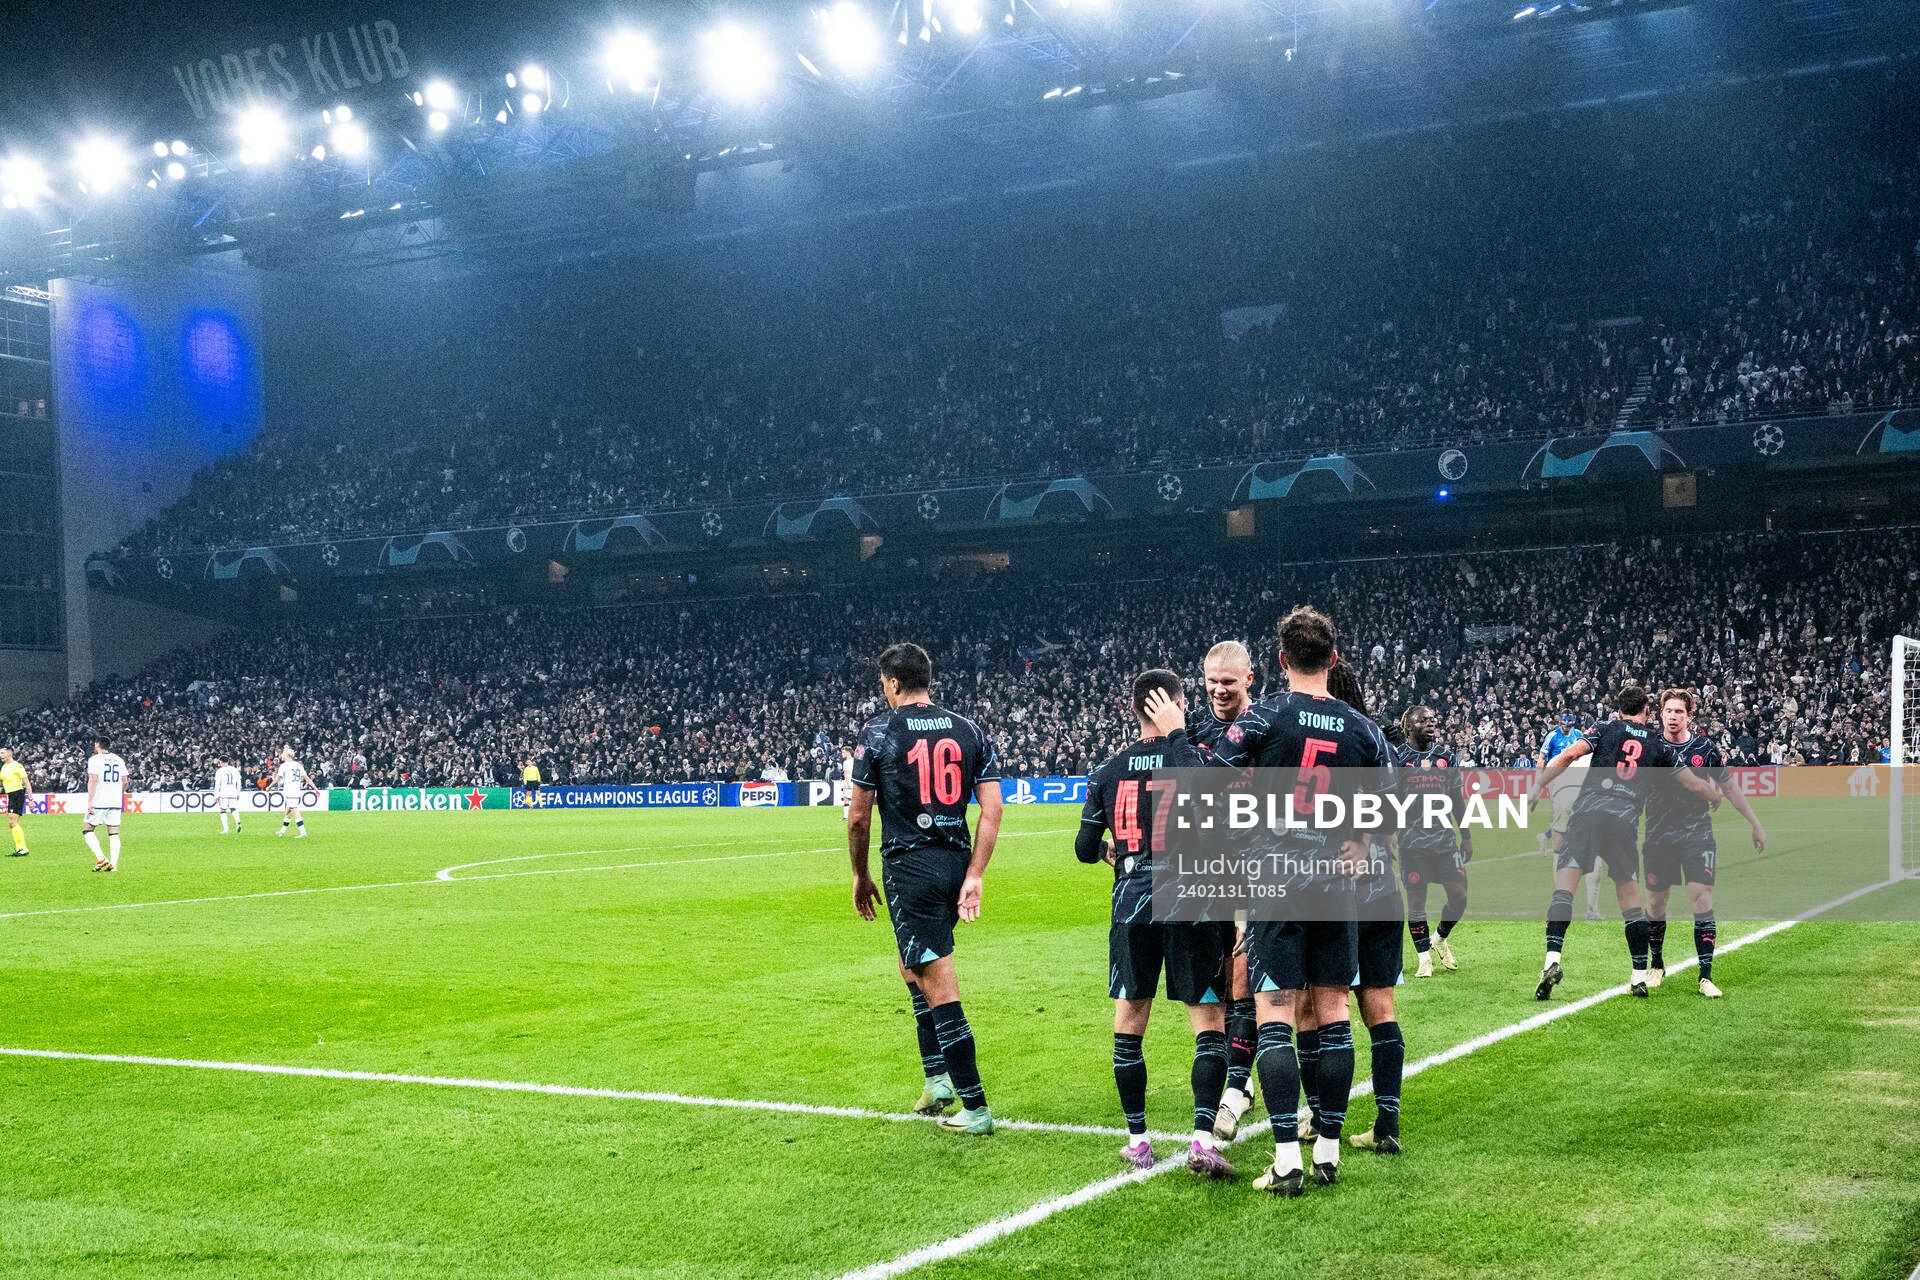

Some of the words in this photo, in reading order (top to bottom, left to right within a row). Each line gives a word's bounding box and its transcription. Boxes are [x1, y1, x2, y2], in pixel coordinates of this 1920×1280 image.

[302, 19, 409, 95] KLUB
[906, 716, 953, 731] RODRIGO
[1298, 710, 1345, 733] STONES
[1128, 754, 1164, 771] FODEN
[1616, 739, 1643, 780] 3
[103, 763, 120, 783] 26
[225, 772, 234, 785] 11
[907, 738, 962, 805] 16
[1293, 737, 1338, 815] 5
[351, 788, 464, 812] Heineken
[566, 790, 643, 806] CHAMPIONS
[648, 790, 699, 804] LEAGUE
[742, 791, 776, 801] PEPSI
[1114, 779, 1177, 852] 47
[1701, 850, 1714, 868] 17
